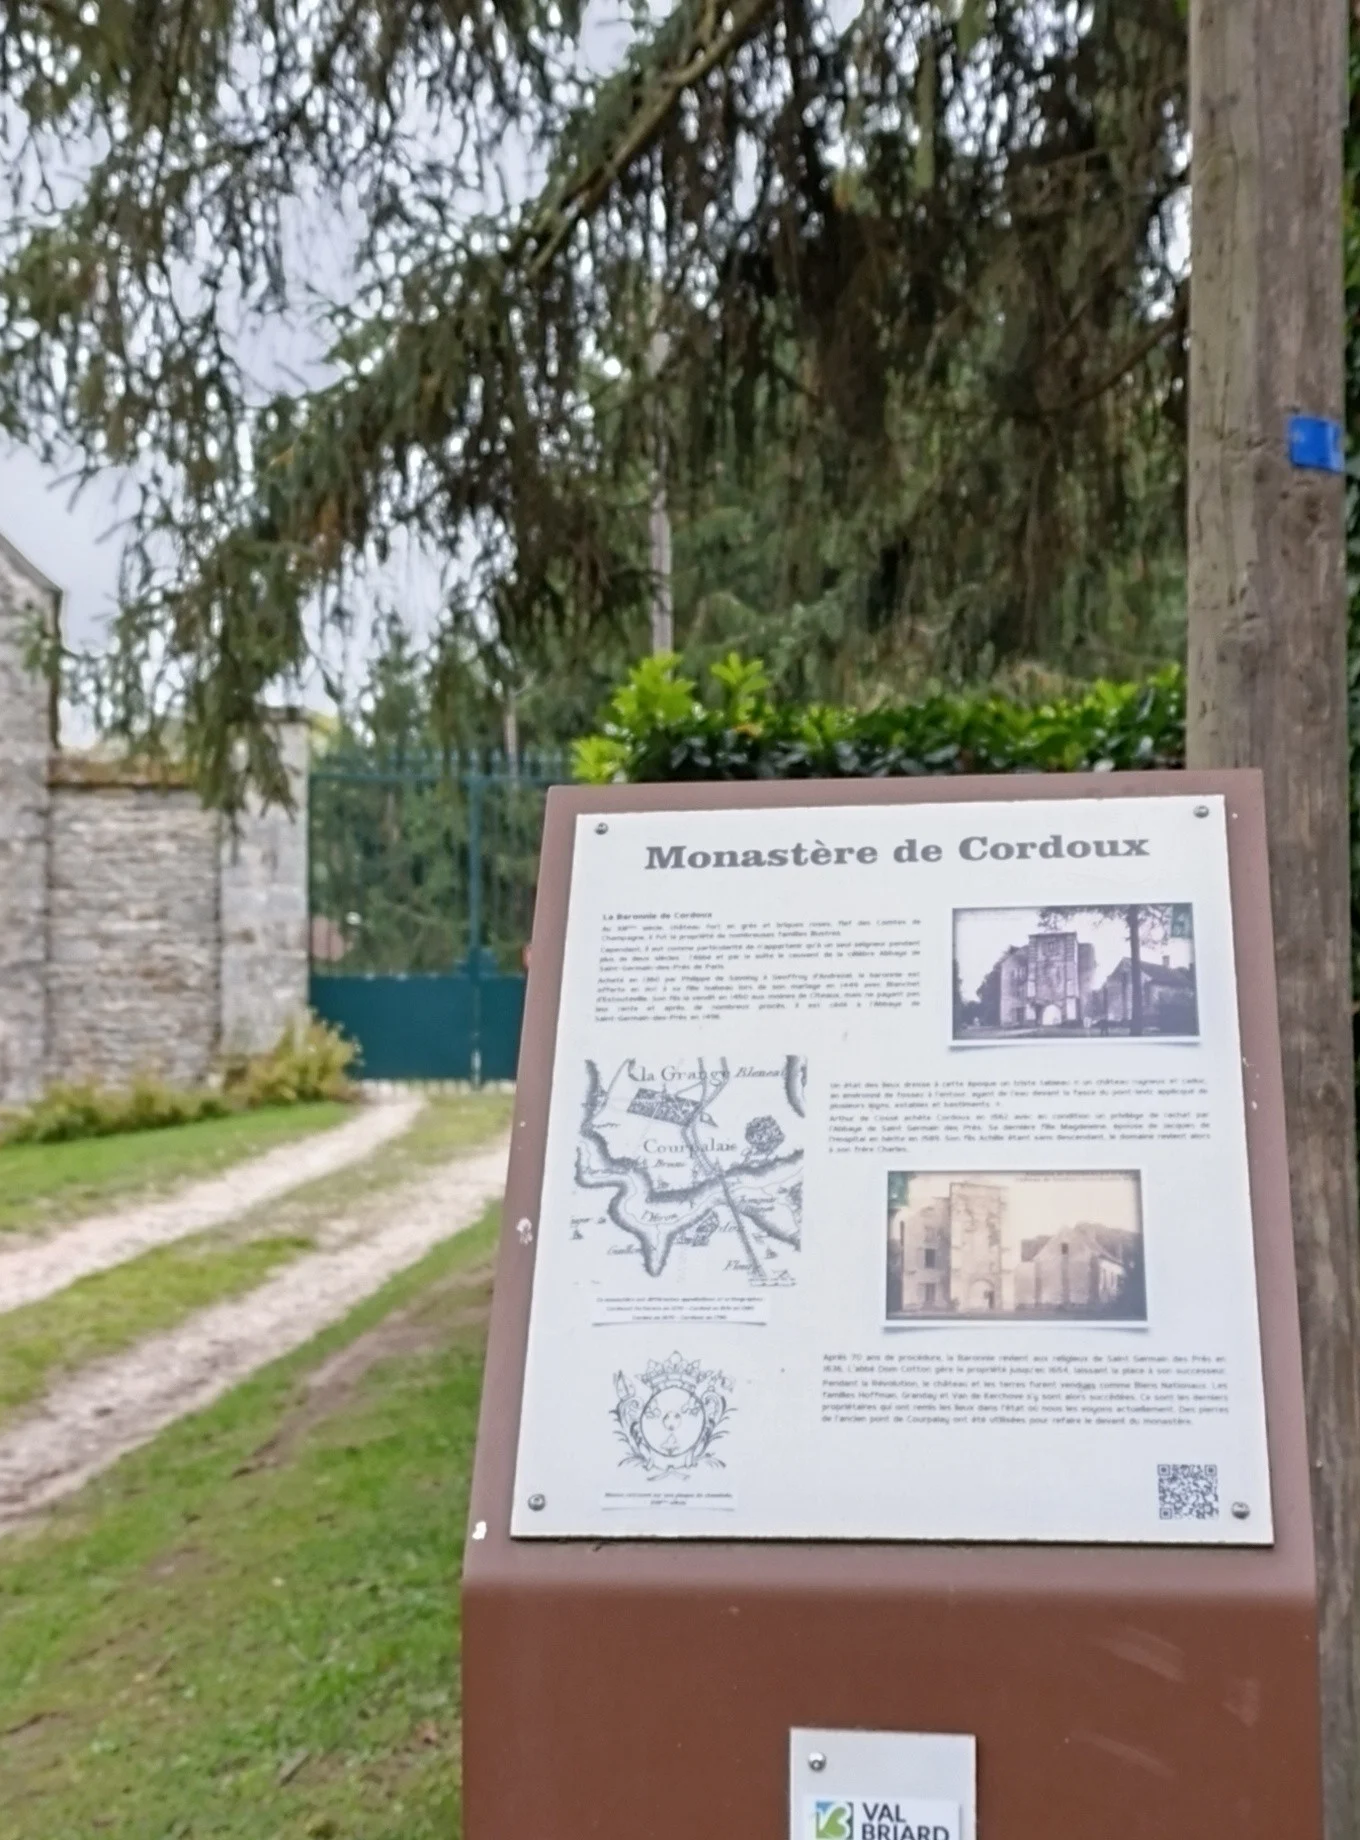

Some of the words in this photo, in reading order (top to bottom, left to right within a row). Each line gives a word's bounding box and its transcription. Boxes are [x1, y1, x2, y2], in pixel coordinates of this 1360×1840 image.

[645, 839, 878, 869] Monastère
[893, 838, 943, 863] de
[958, 834, 1151, 861] Cordoux
[862, 1802, 906, 1823] VAL
[862, 1823, 950, 1840] BRIARD
